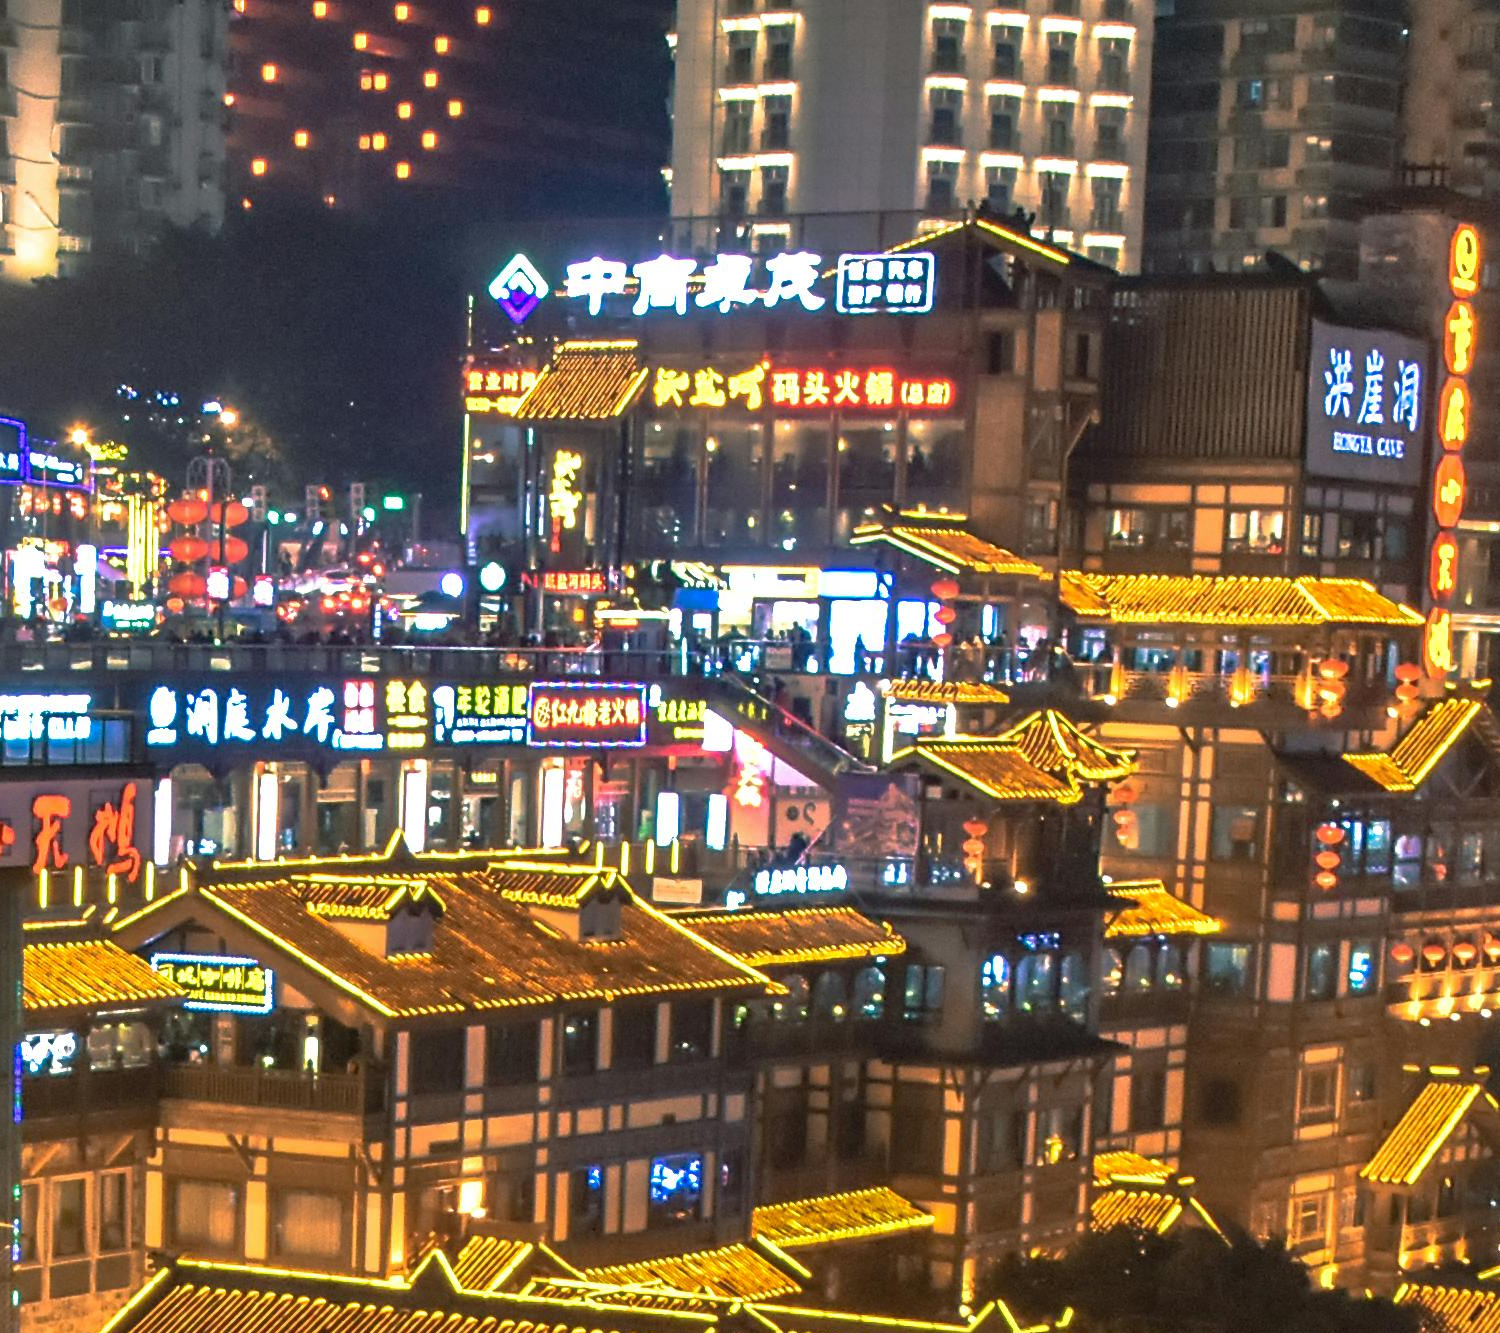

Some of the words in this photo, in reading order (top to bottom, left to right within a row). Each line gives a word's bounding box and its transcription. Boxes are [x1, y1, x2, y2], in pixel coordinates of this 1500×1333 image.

[1324, 348, 1420, 432] 洪崖洞
[1332, 432, 1373, 455] HONGYA
[1376, 438, 1405, 459] CAVE
[186, 686, 335, 744] 洞庭水岸
